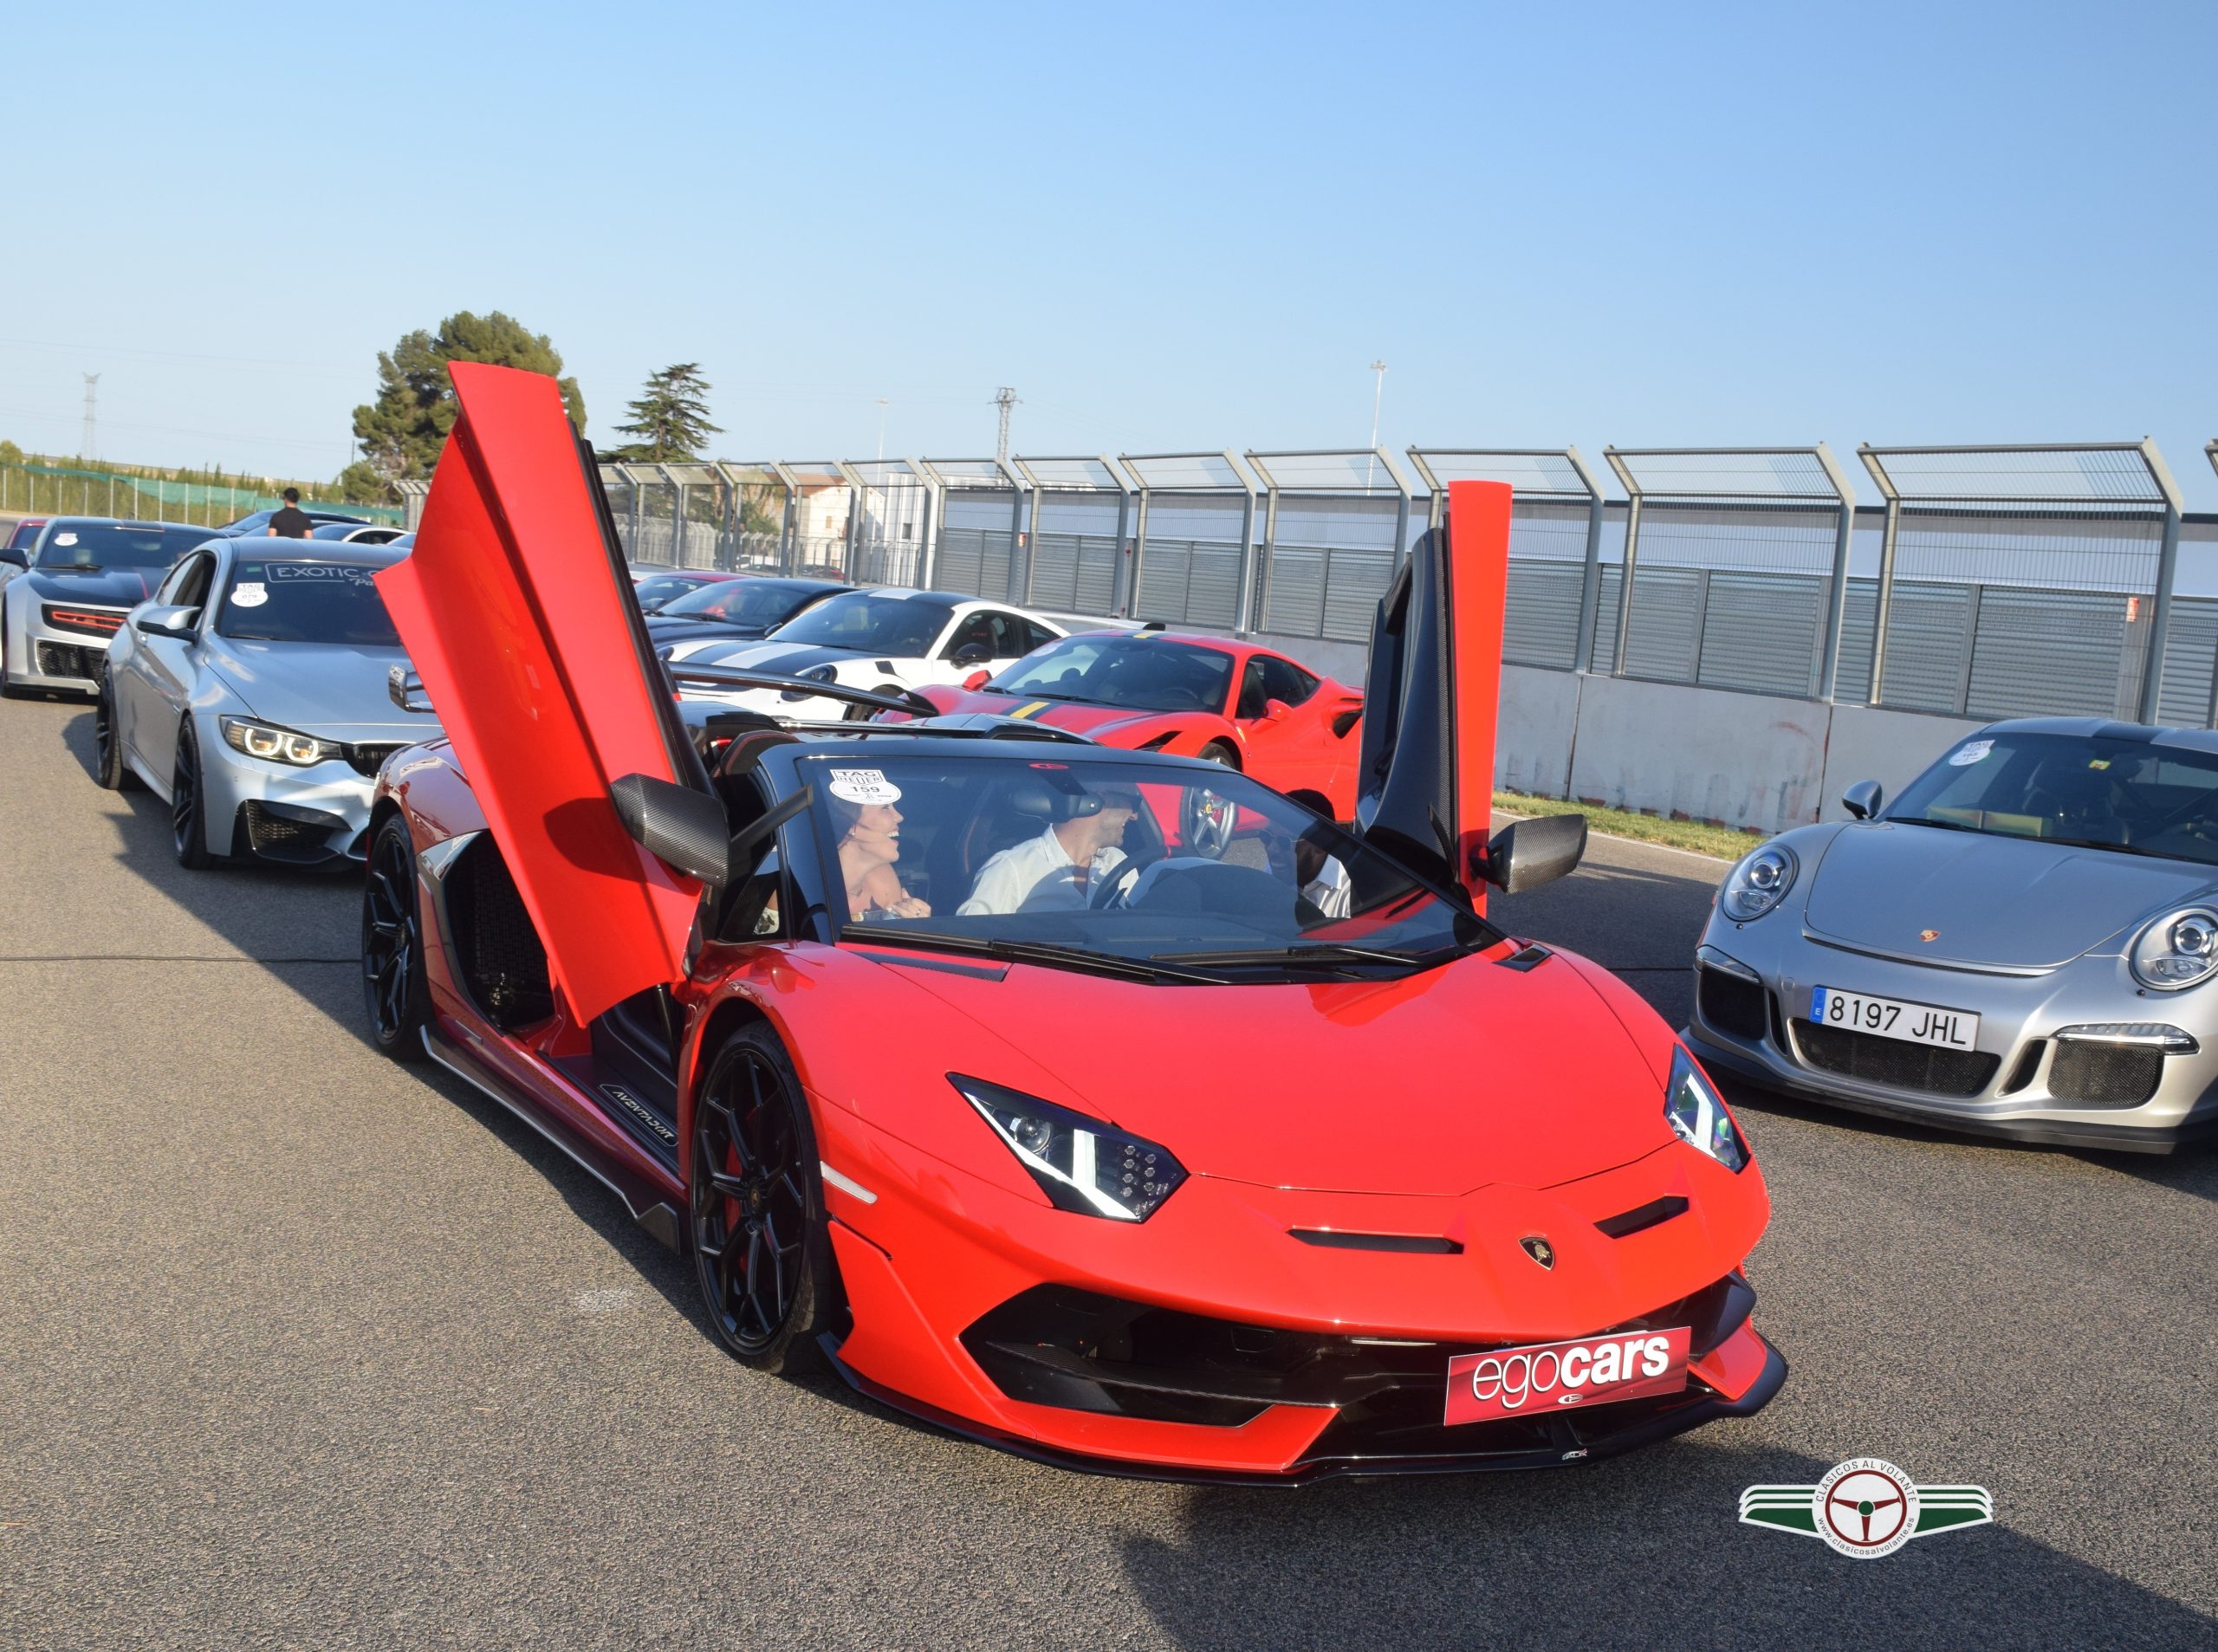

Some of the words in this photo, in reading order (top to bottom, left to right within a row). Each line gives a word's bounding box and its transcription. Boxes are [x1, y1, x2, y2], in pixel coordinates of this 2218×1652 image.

[277, 567, 360, 578] EXOTIC
[1829, 995, 1902, 1032] 8197
[1911, 1012, 1967, 1046] JHL
[612, 1091, 675, 1138] AVENTADOR
[1473, 1336, 1670, 1409] egocars
